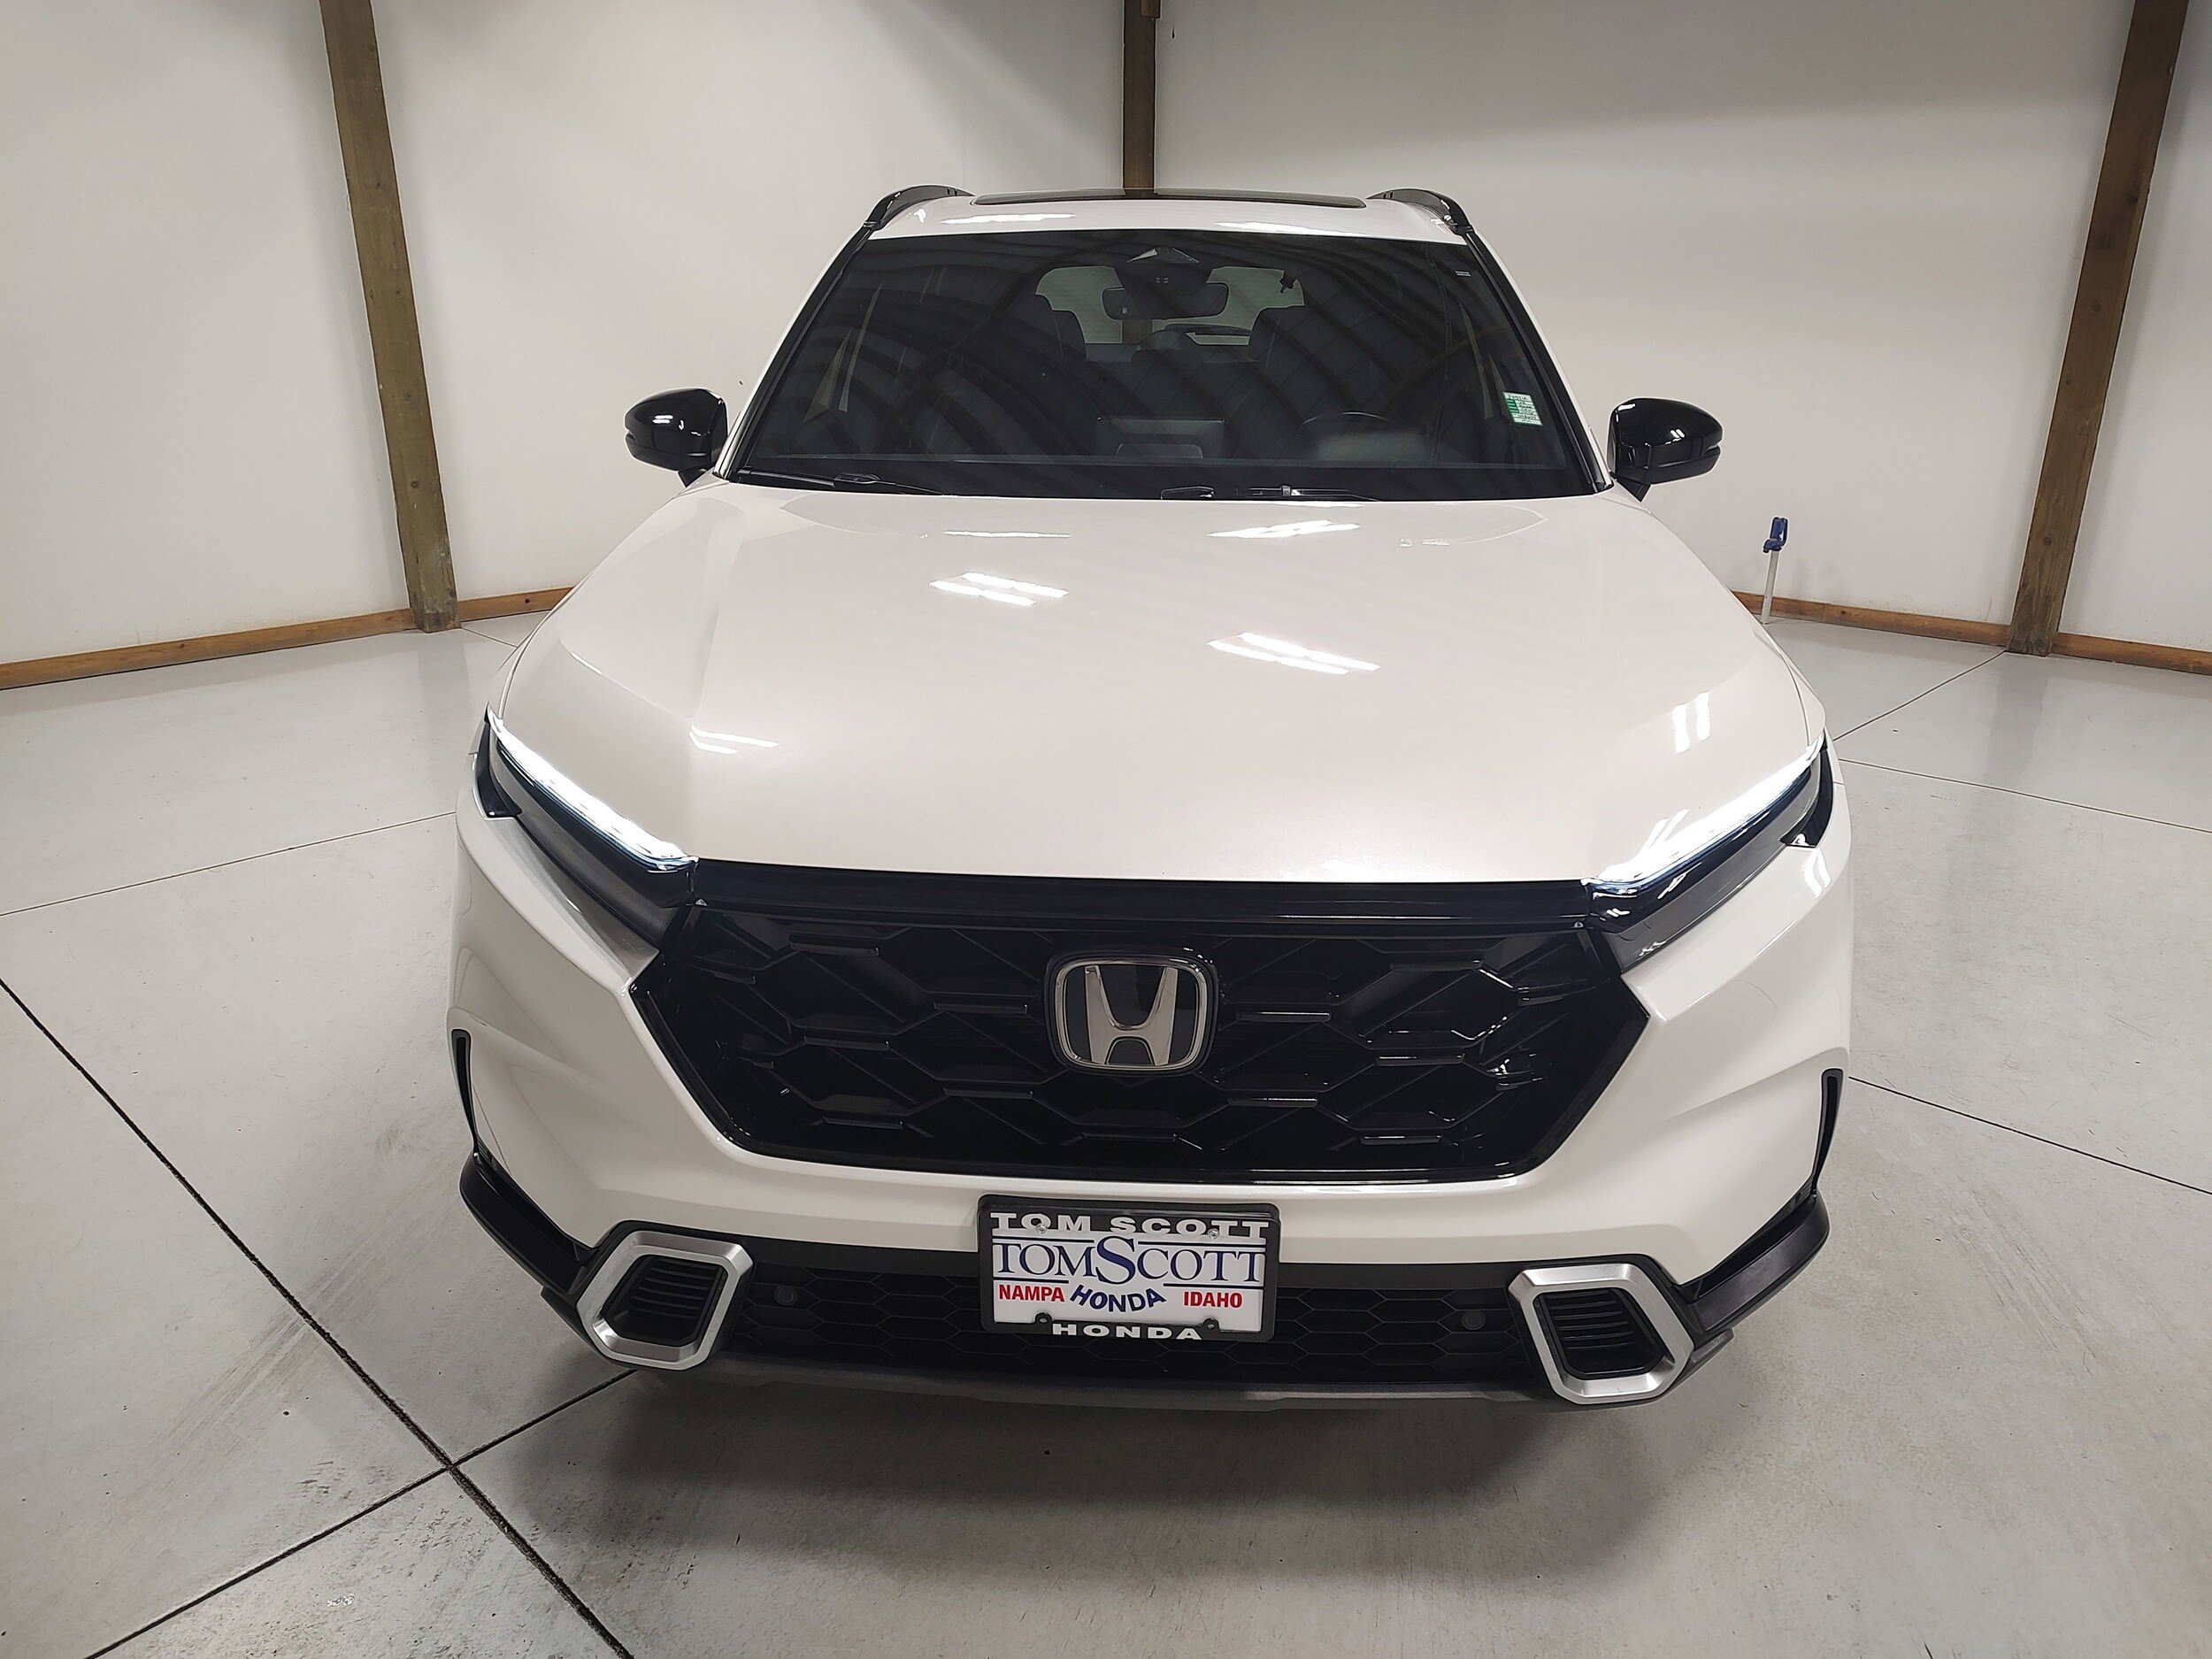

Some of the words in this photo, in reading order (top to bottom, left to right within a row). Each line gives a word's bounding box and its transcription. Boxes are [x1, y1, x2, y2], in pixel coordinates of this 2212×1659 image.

[990, 1212, 1092, 1233] TOM
[1110, 1217, 1270, 1239] SCOTT
[998, 1284, 1065, 1302] NAMPA
[1069, 1285, 1167, 1313] HONDA
[1183, 1290, 1243, 1309] IDAHO
[1052, 1323, 1203, 1340] HONDA
